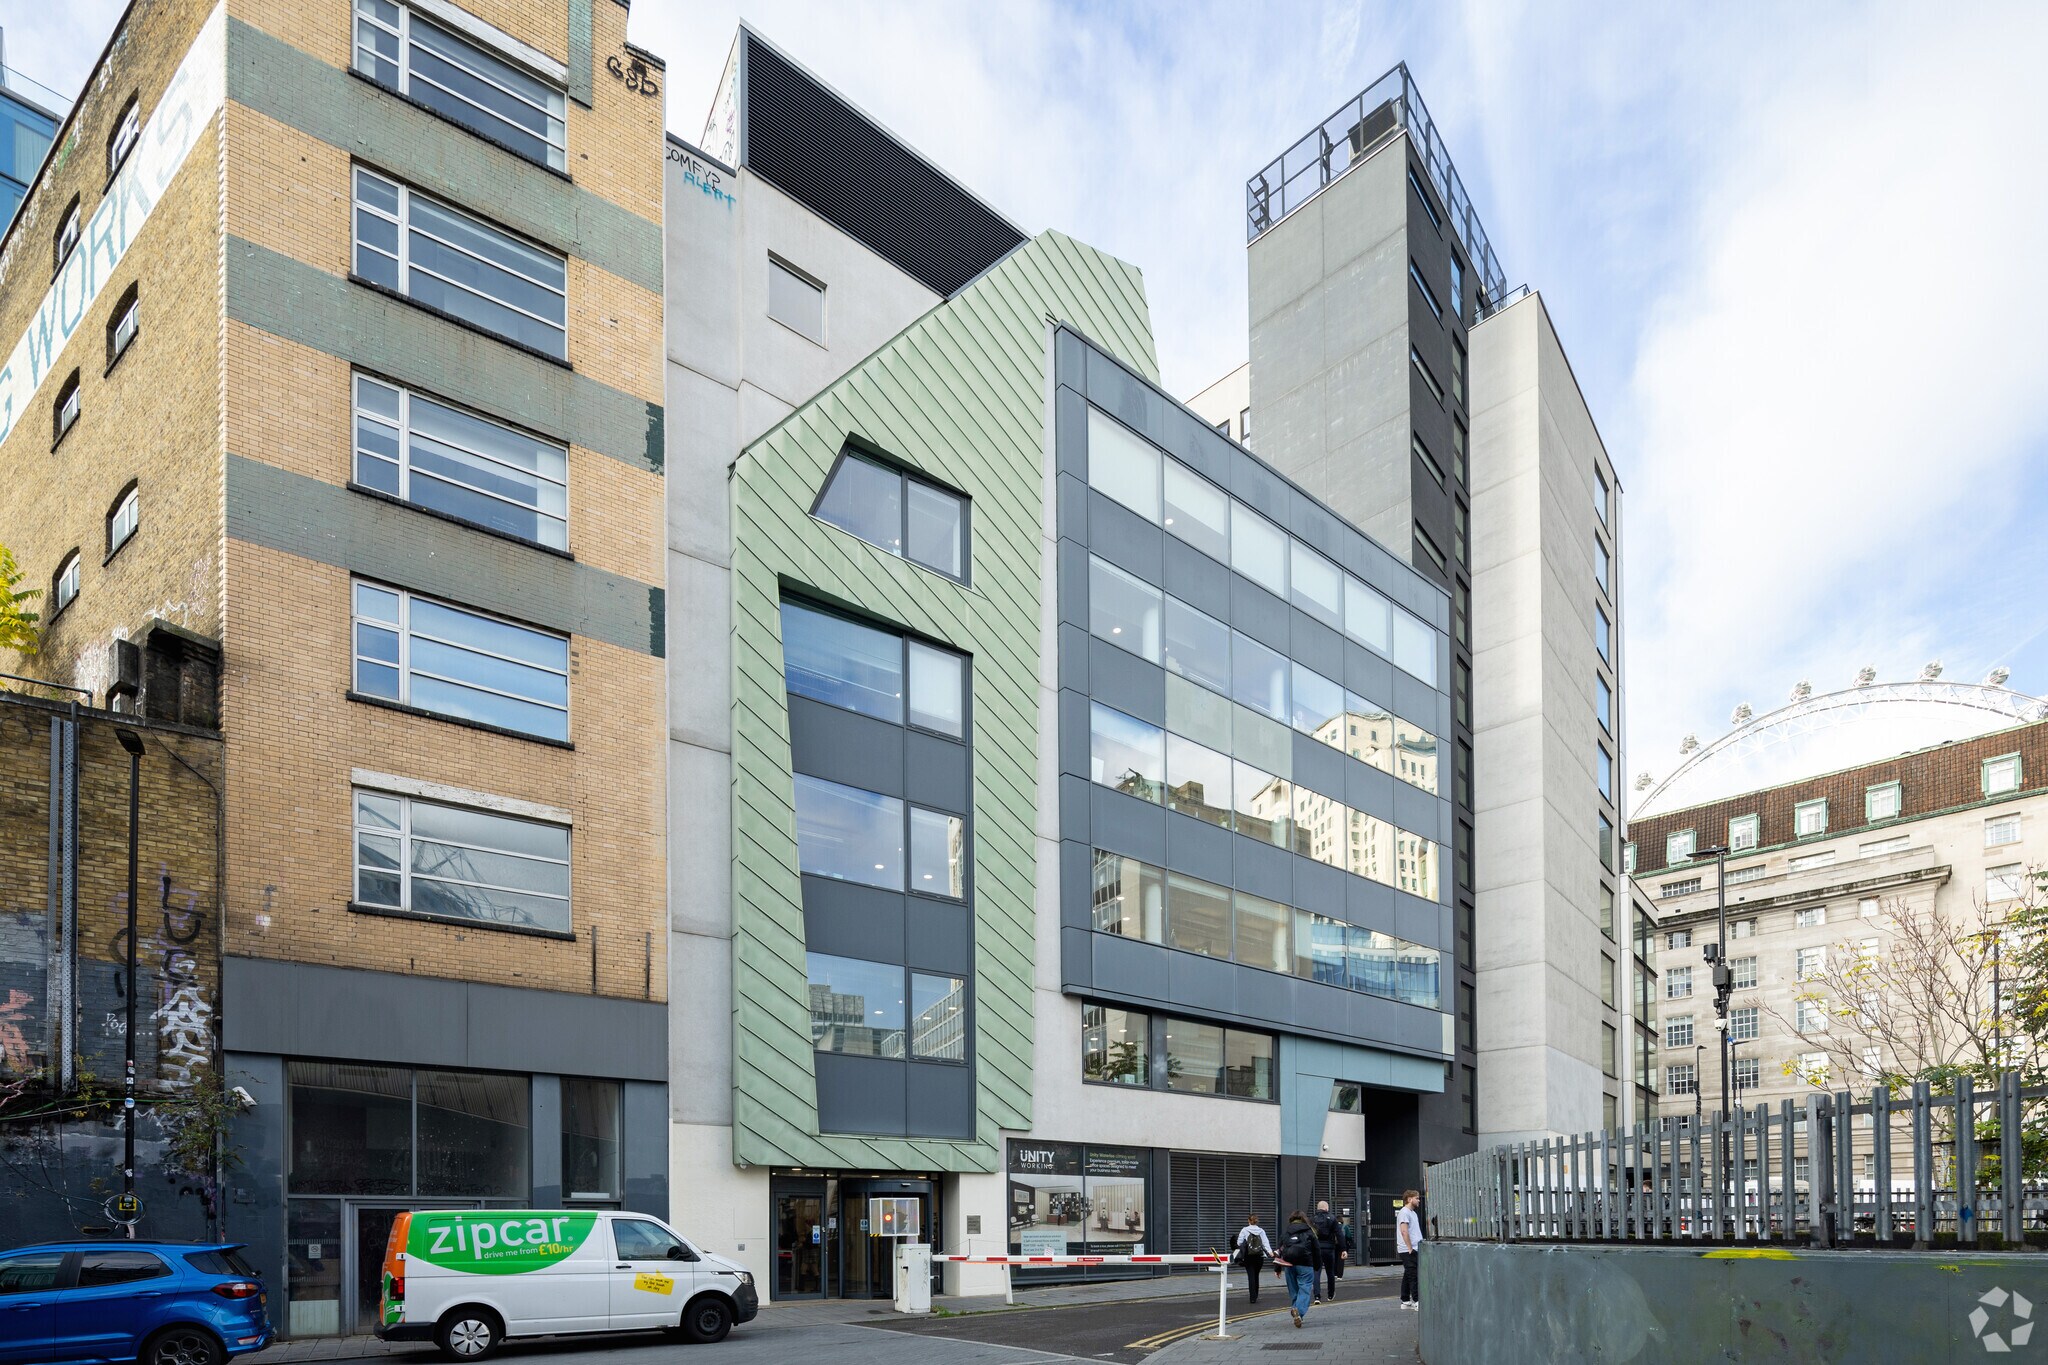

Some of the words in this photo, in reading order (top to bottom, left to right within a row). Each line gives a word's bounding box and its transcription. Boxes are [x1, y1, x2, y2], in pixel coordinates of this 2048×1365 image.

[683, 171, 737, 210] ALERT
[27, 67, 194, 390] WORKS
[1020, 1149, 1055, 1163] UNITY
[1021, 1162, 1054, 1170] WORKING
[428, 1216, 570, 1260] zipcar
[484, 1250, 504, 1259] drive
[519, 1247, 539, 1255] from
[538, 1243, 574, 1256] £10/hr
